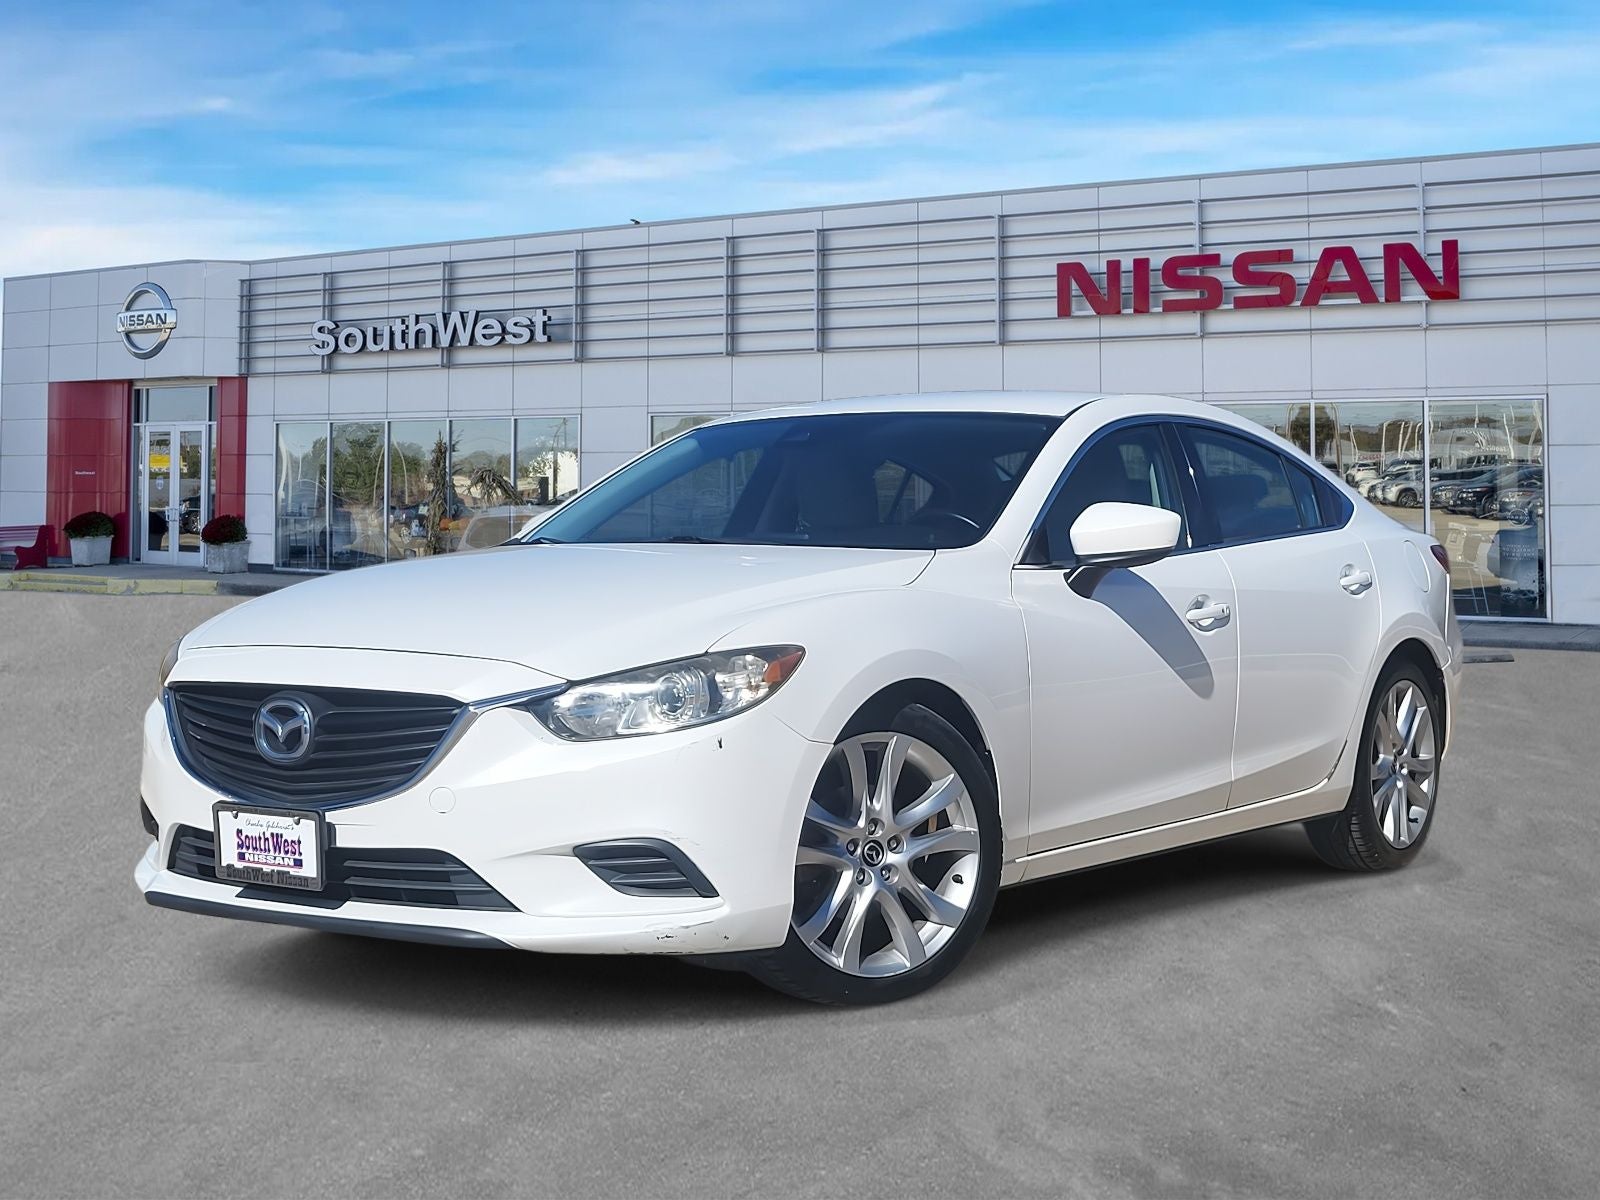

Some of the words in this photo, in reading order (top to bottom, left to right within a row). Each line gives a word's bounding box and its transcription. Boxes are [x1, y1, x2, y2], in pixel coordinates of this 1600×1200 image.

[1056, 239, 1460, 318] NISSAN
[119, 312, 167, 328] NISSAN
[309, 308, 551, 356] SouthWest
[236, 828, 302, 857] SouthWest
[245, 852, 295, 866] NISSAN
[276, 869, 310, 888] Nissan
